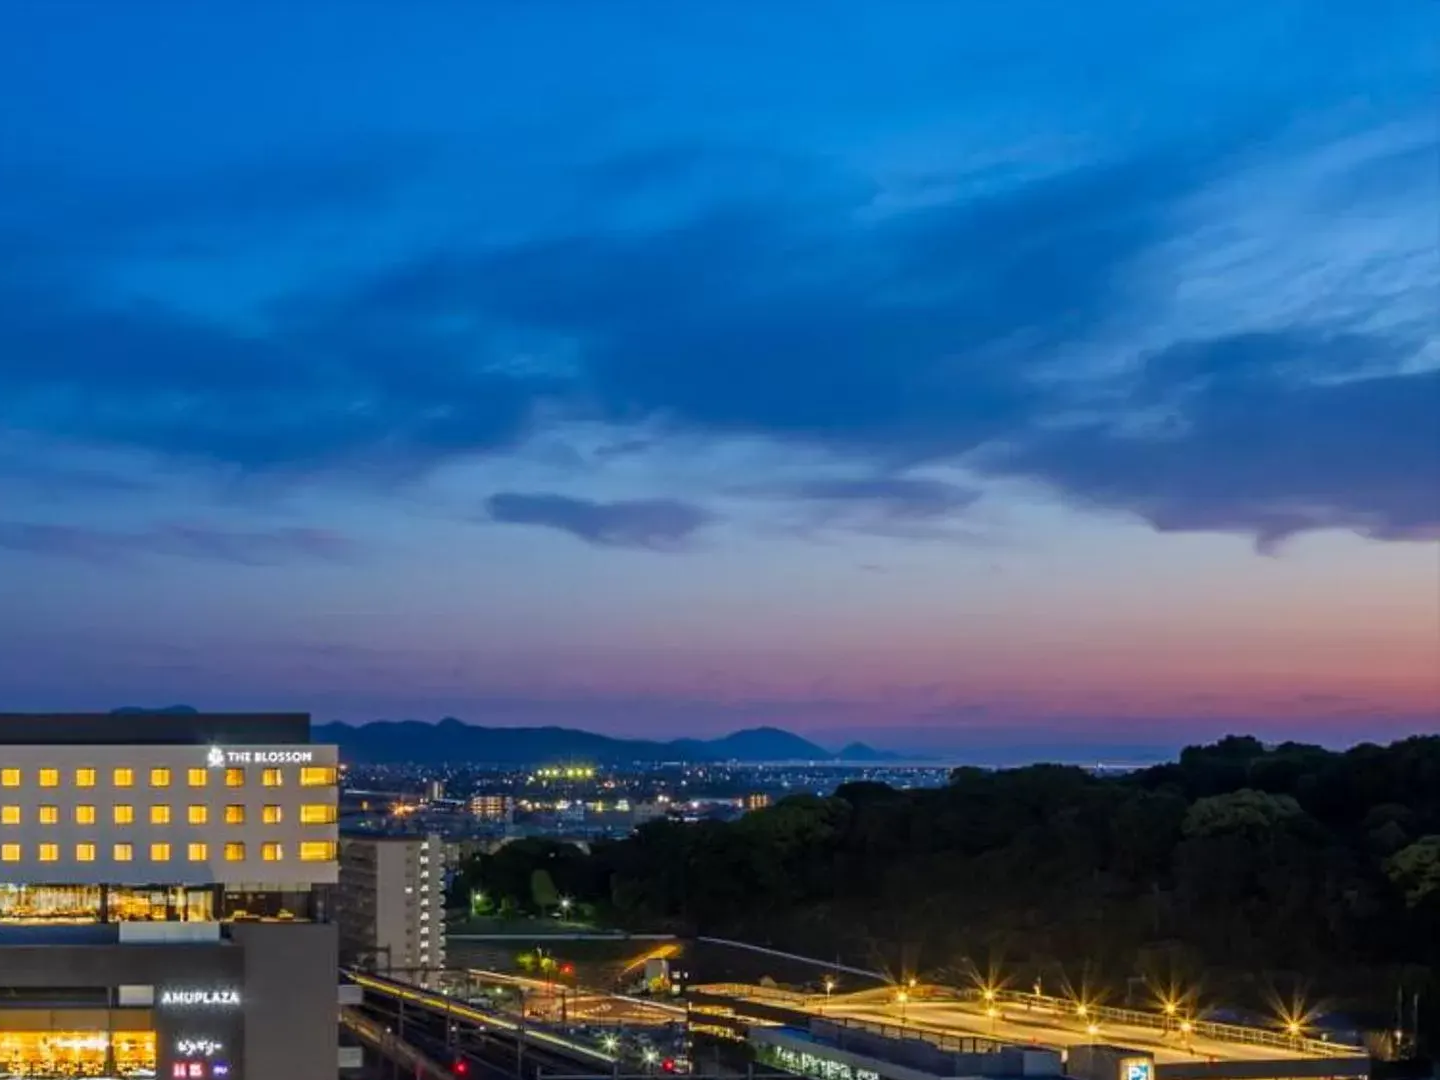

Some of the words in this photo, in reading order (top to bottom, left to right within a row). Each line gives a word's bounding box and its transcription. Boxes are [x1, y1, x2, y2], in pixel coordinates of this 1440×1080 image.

[227, 751, 251, 763] THE
[254, 751, 312, 763] BLOSSOM
[161, 991, 241, 1004] AMUPLAZA
